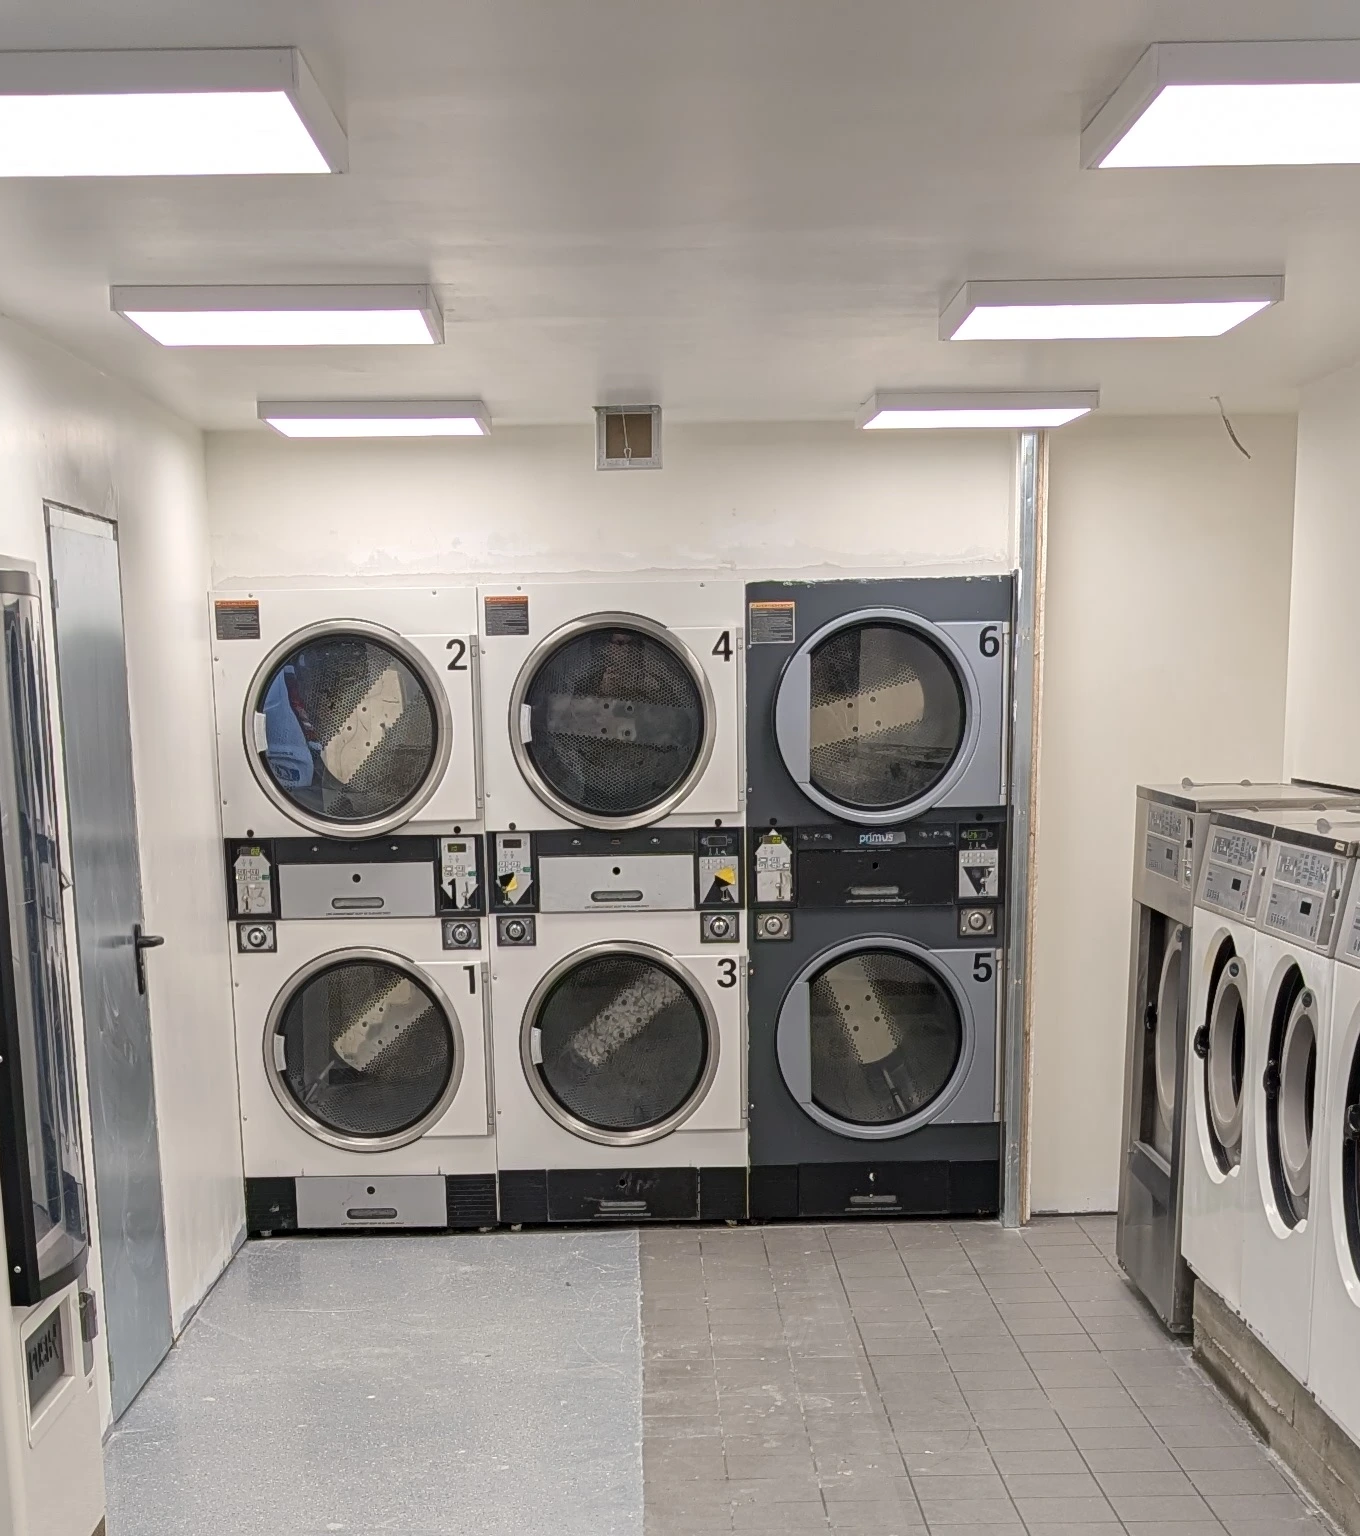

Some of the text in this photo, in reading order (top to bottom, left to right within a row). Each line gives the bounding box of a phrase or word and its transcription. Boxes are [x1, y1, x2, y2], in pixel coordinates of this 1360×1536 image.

[446, 638, 468, 670] 2
[711, 630, 734, 662] 4
[979, 625, 1000, 658] 6
[859, 832, 894, 845] primus
[462, 965, 476, 994] 1
[717, 958, 737, 988] 3
[973, 952, 992, 982] 5
